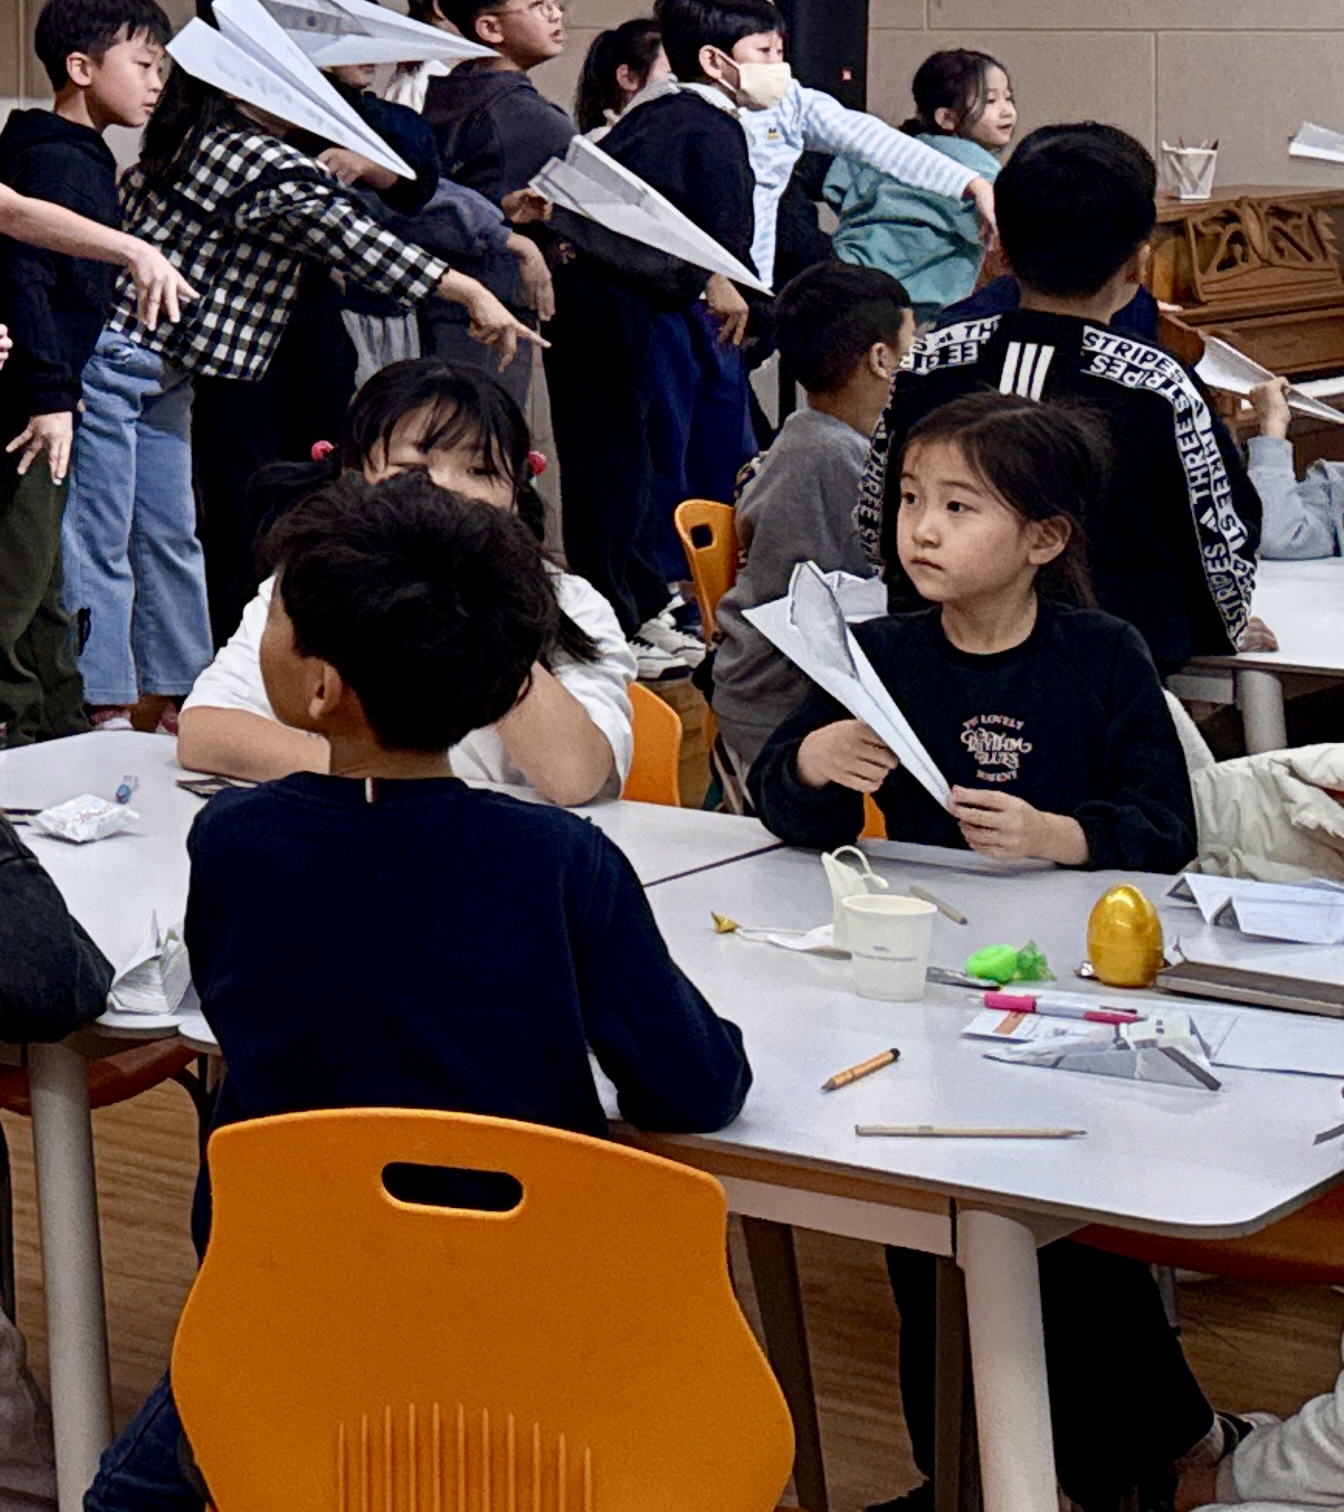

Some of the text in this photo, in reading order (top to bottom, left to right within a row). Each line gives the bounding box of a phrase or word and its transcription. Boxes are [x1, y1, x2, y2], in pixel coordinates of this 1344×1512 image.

[1084, 331, 1185, 384] STRIPES
[1090, 354, 1190, 414] STRIPES
[1175, 416, 1211, 505] THREE
